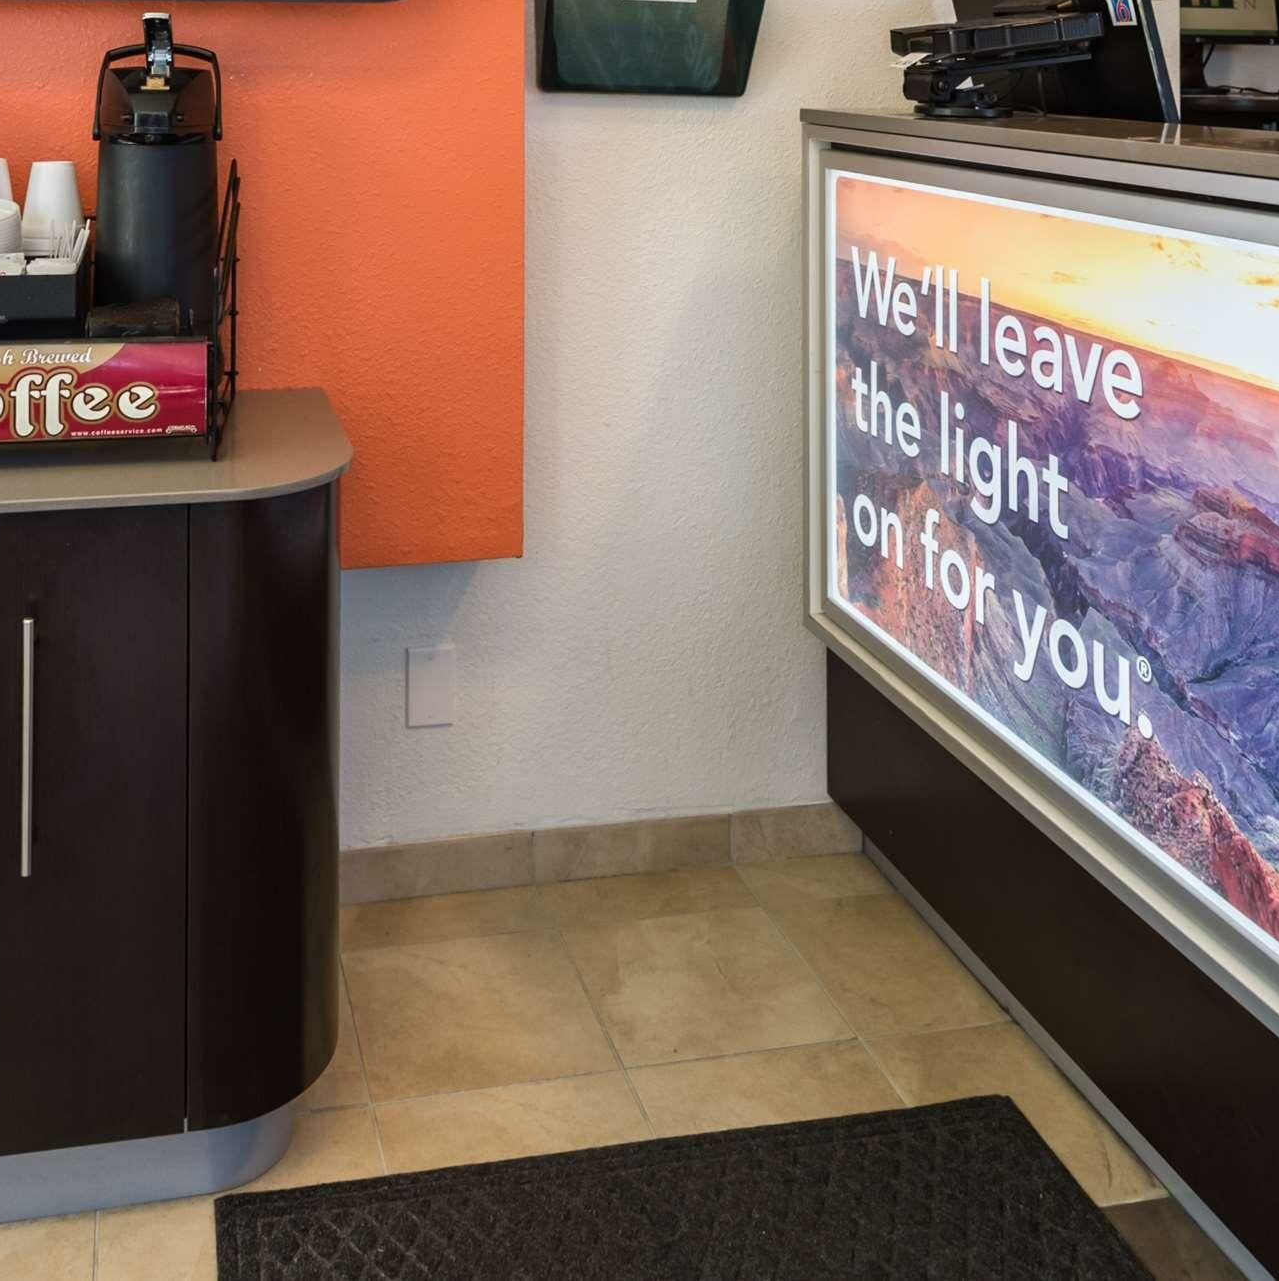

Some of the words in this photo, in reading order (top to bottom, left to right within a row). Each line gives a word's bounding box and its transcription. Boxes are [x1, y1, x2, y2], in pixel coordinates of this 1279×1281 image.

[20, 346, 92, 366] Brewed
[851, 245, 958, 353] We'll
[980, 278, 1144, 420] leave
[70, 427, 163, 437] www.coffeeservice.com
[851, 360, 921, 457] the
[939, 390, 1070, 541] light
[854, 492, 904, 569] on
[920, 509, 995, 624] for
